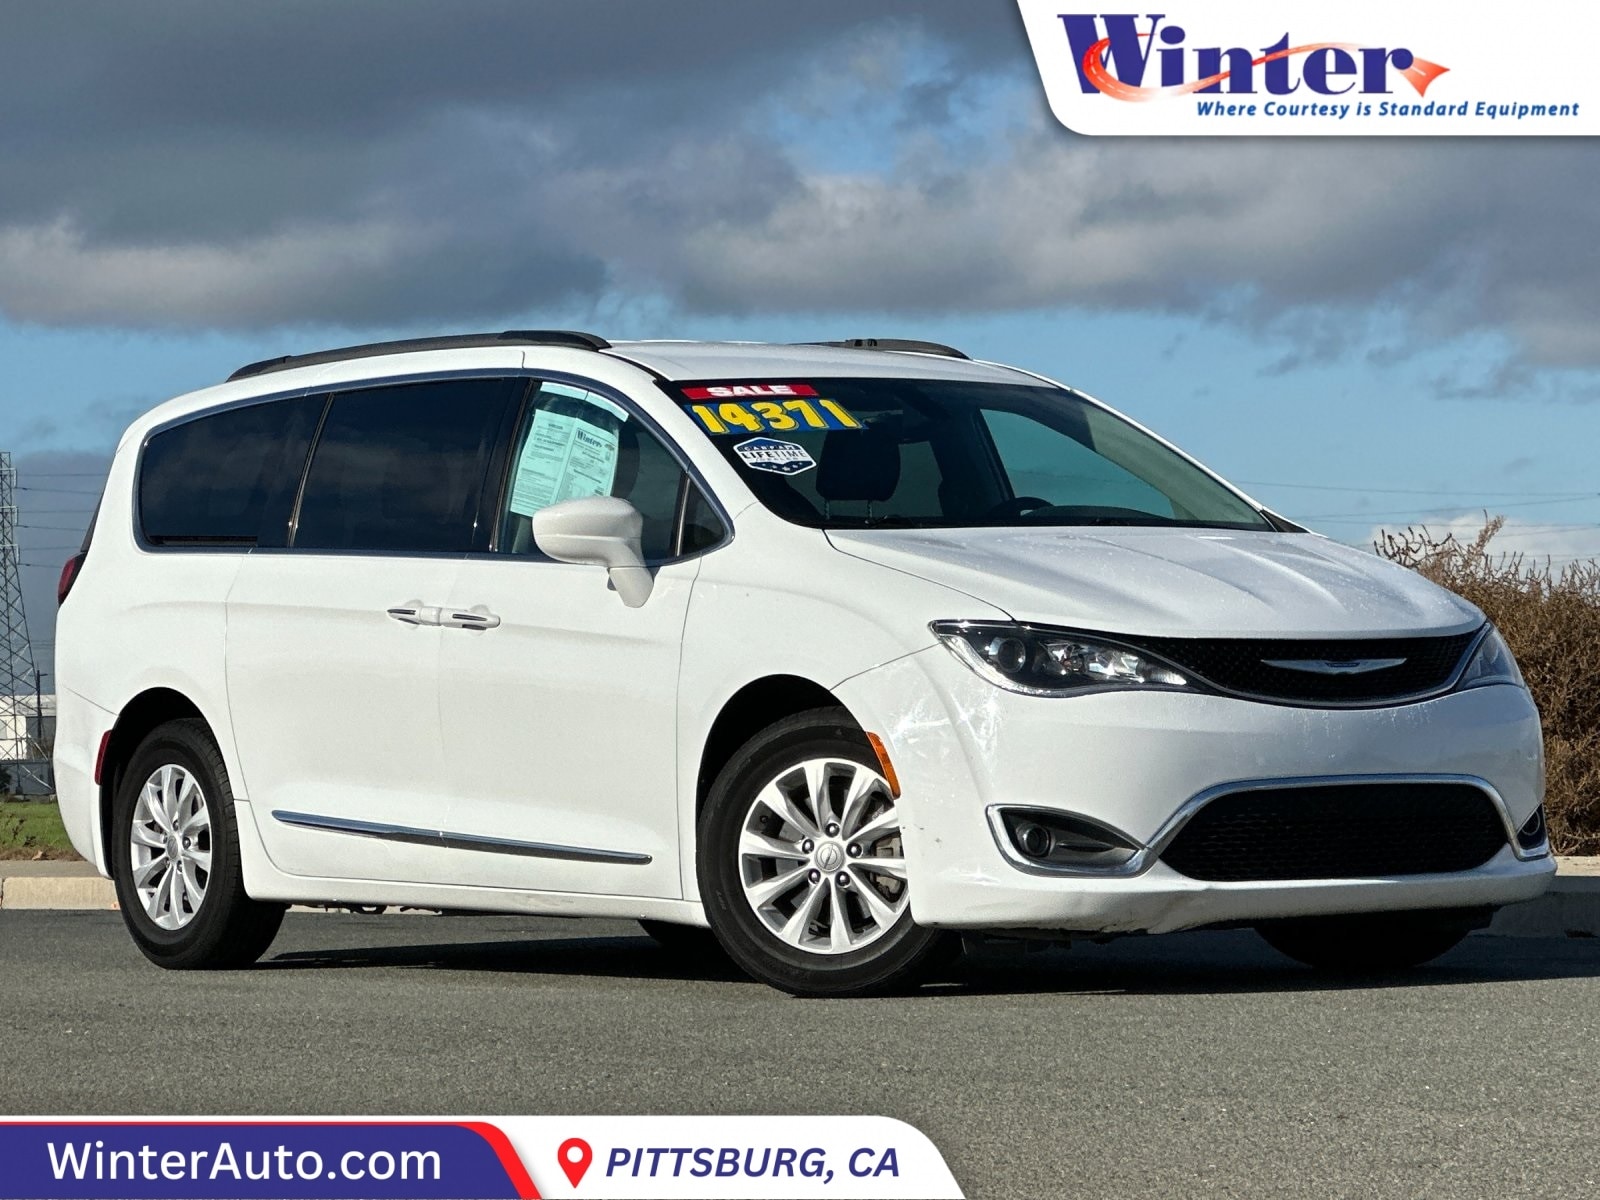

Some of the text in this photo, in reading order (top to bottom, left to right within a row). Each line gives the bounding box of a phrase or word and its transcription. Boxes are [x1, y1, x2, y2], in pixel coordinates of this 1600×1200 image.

[706, 385, 796, 396] SALE
[691, 399, 863, 433] 14371
[741, 451, 808, 459] LIFETIME
